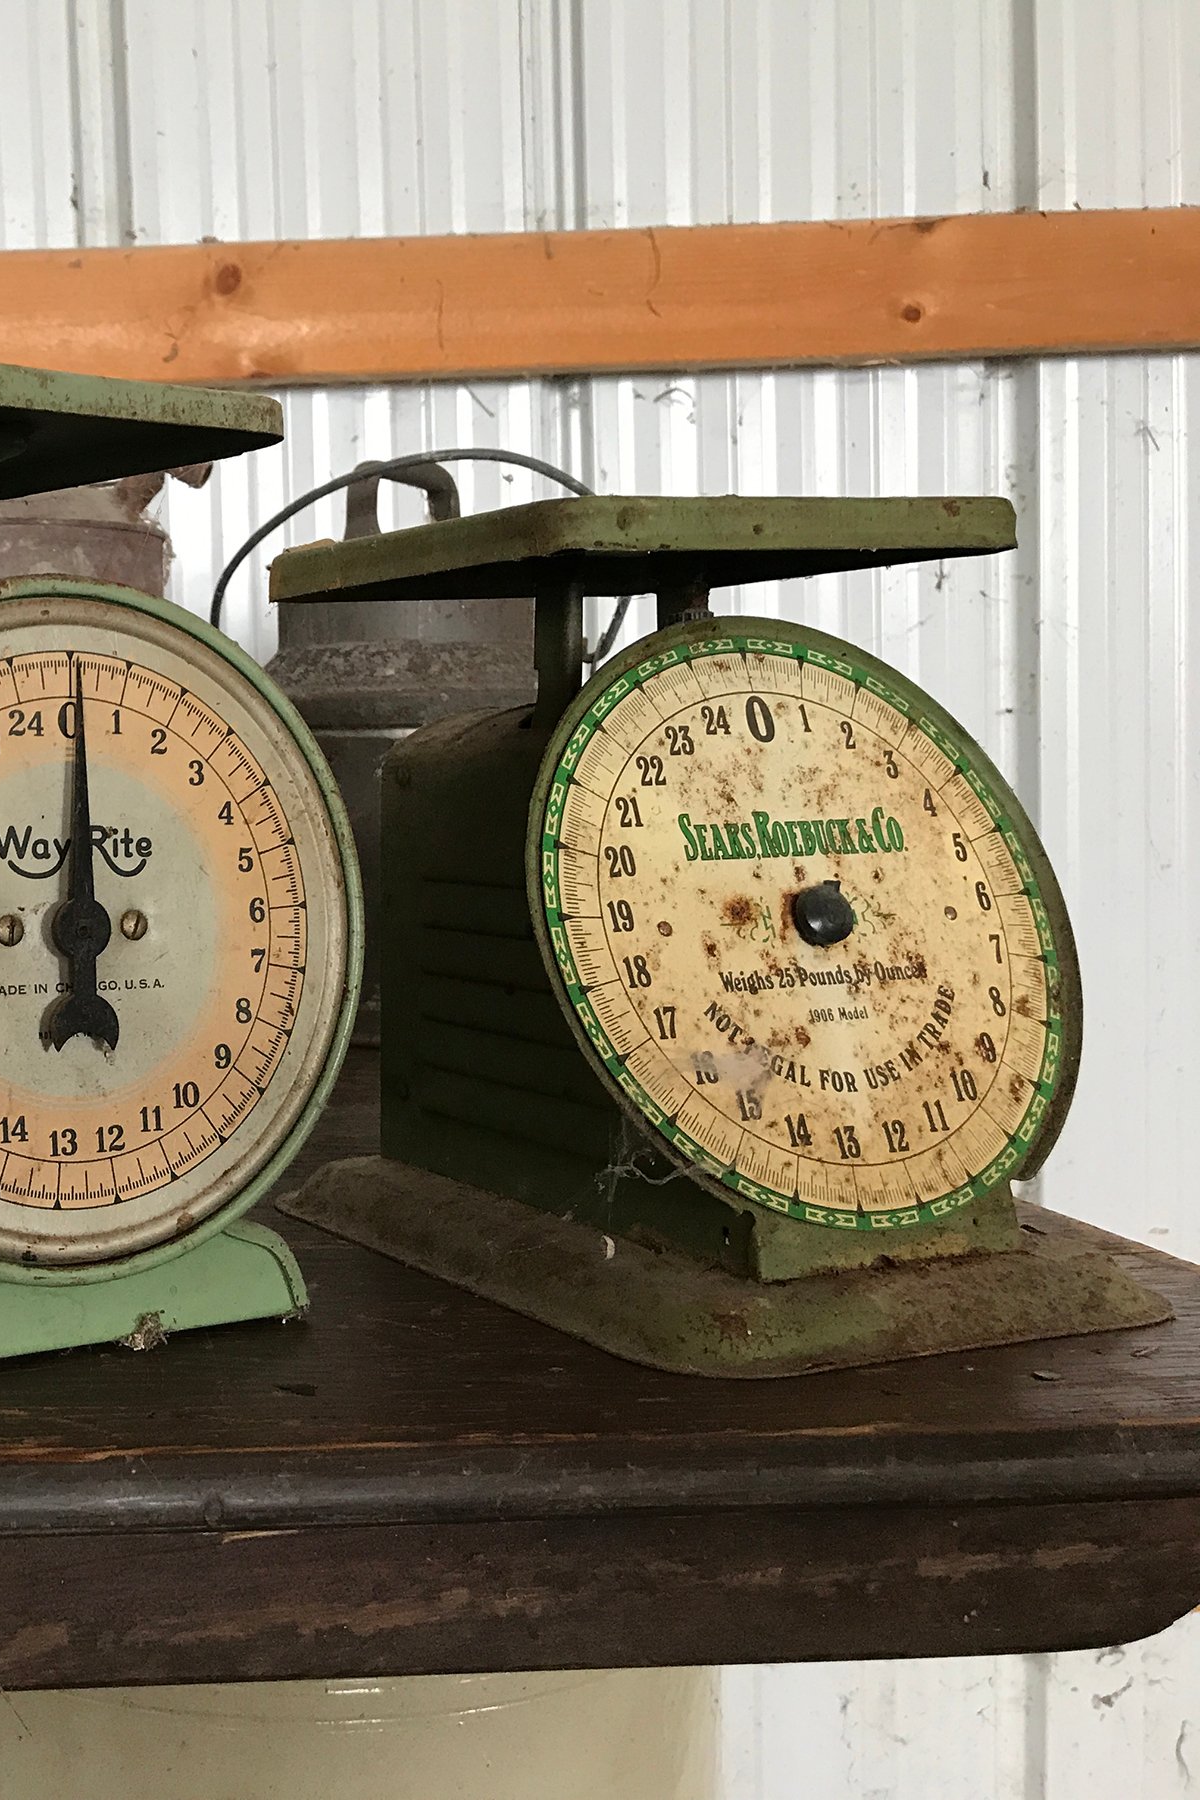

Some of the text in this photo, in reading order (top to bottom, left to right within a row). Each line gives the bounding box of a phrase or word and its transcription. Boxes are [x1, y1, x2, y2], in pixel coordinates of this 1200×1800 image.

[8, 711, 43, 736] 24
[58, 702, 78, 739] 0
[112, 712, 121, 735] 1
[702, 705, 730, 736] 24
[745, 696, 775, 742] 0
[800, 704, 811, 732] 1
[151, 729, 168, 754] 2
[666, 726, 694, 756] 23
[842, 722, 856, 749] 2
[189, 761, 204, 786] 3
[636, 756, 666, 786] 22
[884, 752, 898, 778] 3
[218, 801, 233, 825] 4
[616, 798, 642, 827] 21
[923, 788, 936, 816] 4
[90, 825, 152, 877] Rite
[238, 848, 254, 873] 5
[952, 834, 966, 862] 5
[606, 848, 636, 877] 20
[250, 898, 265, 921] 6
[976, 882, 990, 910] 6
[608, 901, 634, 932] 19
[250, 949, 265, 973] 7
[989, 935, 1000, 962] 7
[624, 955, 651, 988] 18
[719, 971, 774, 995] Weighs
[779, 970, 796, 988] 25
[800, 964, 850, 987] Pounds
[853, 964, 872, 987] by
[34, 983, 48, 994] IN
[992, 987, 1006, 1016] 8
[236, 998, 251, 1023] 8
[654, 1006, 677, 1040] 17
[809, 1006, 868, 1023] 1906 Model
[704, 1001, 743, 1045] NOT
[819, 1069, 858, 1092] FOR
[863, 1060, 900, 1090] USE
[900, 1041, 924, 1071] IN
[916, 985, 955, 1050] TRADE
[982, 1034, 997, 1062] 9
[215, 1044, 231, 1069] 9
[173, 1081, 199, 1108] 10
[950, 1070, 978, 1102] 10
[1, 1116, 28, 1143] 14
[140, 1107, 163, 1132] 11
[784, 1115, 811, 1146] 14
[923, 1101, 950, 1132] 11
[49, 1130, 77, 1156] 13
[96, 1126, 125, 1152] 12
[836, 1126, 860, 1158] 13
[882, 1120, 908, 1152] 12
